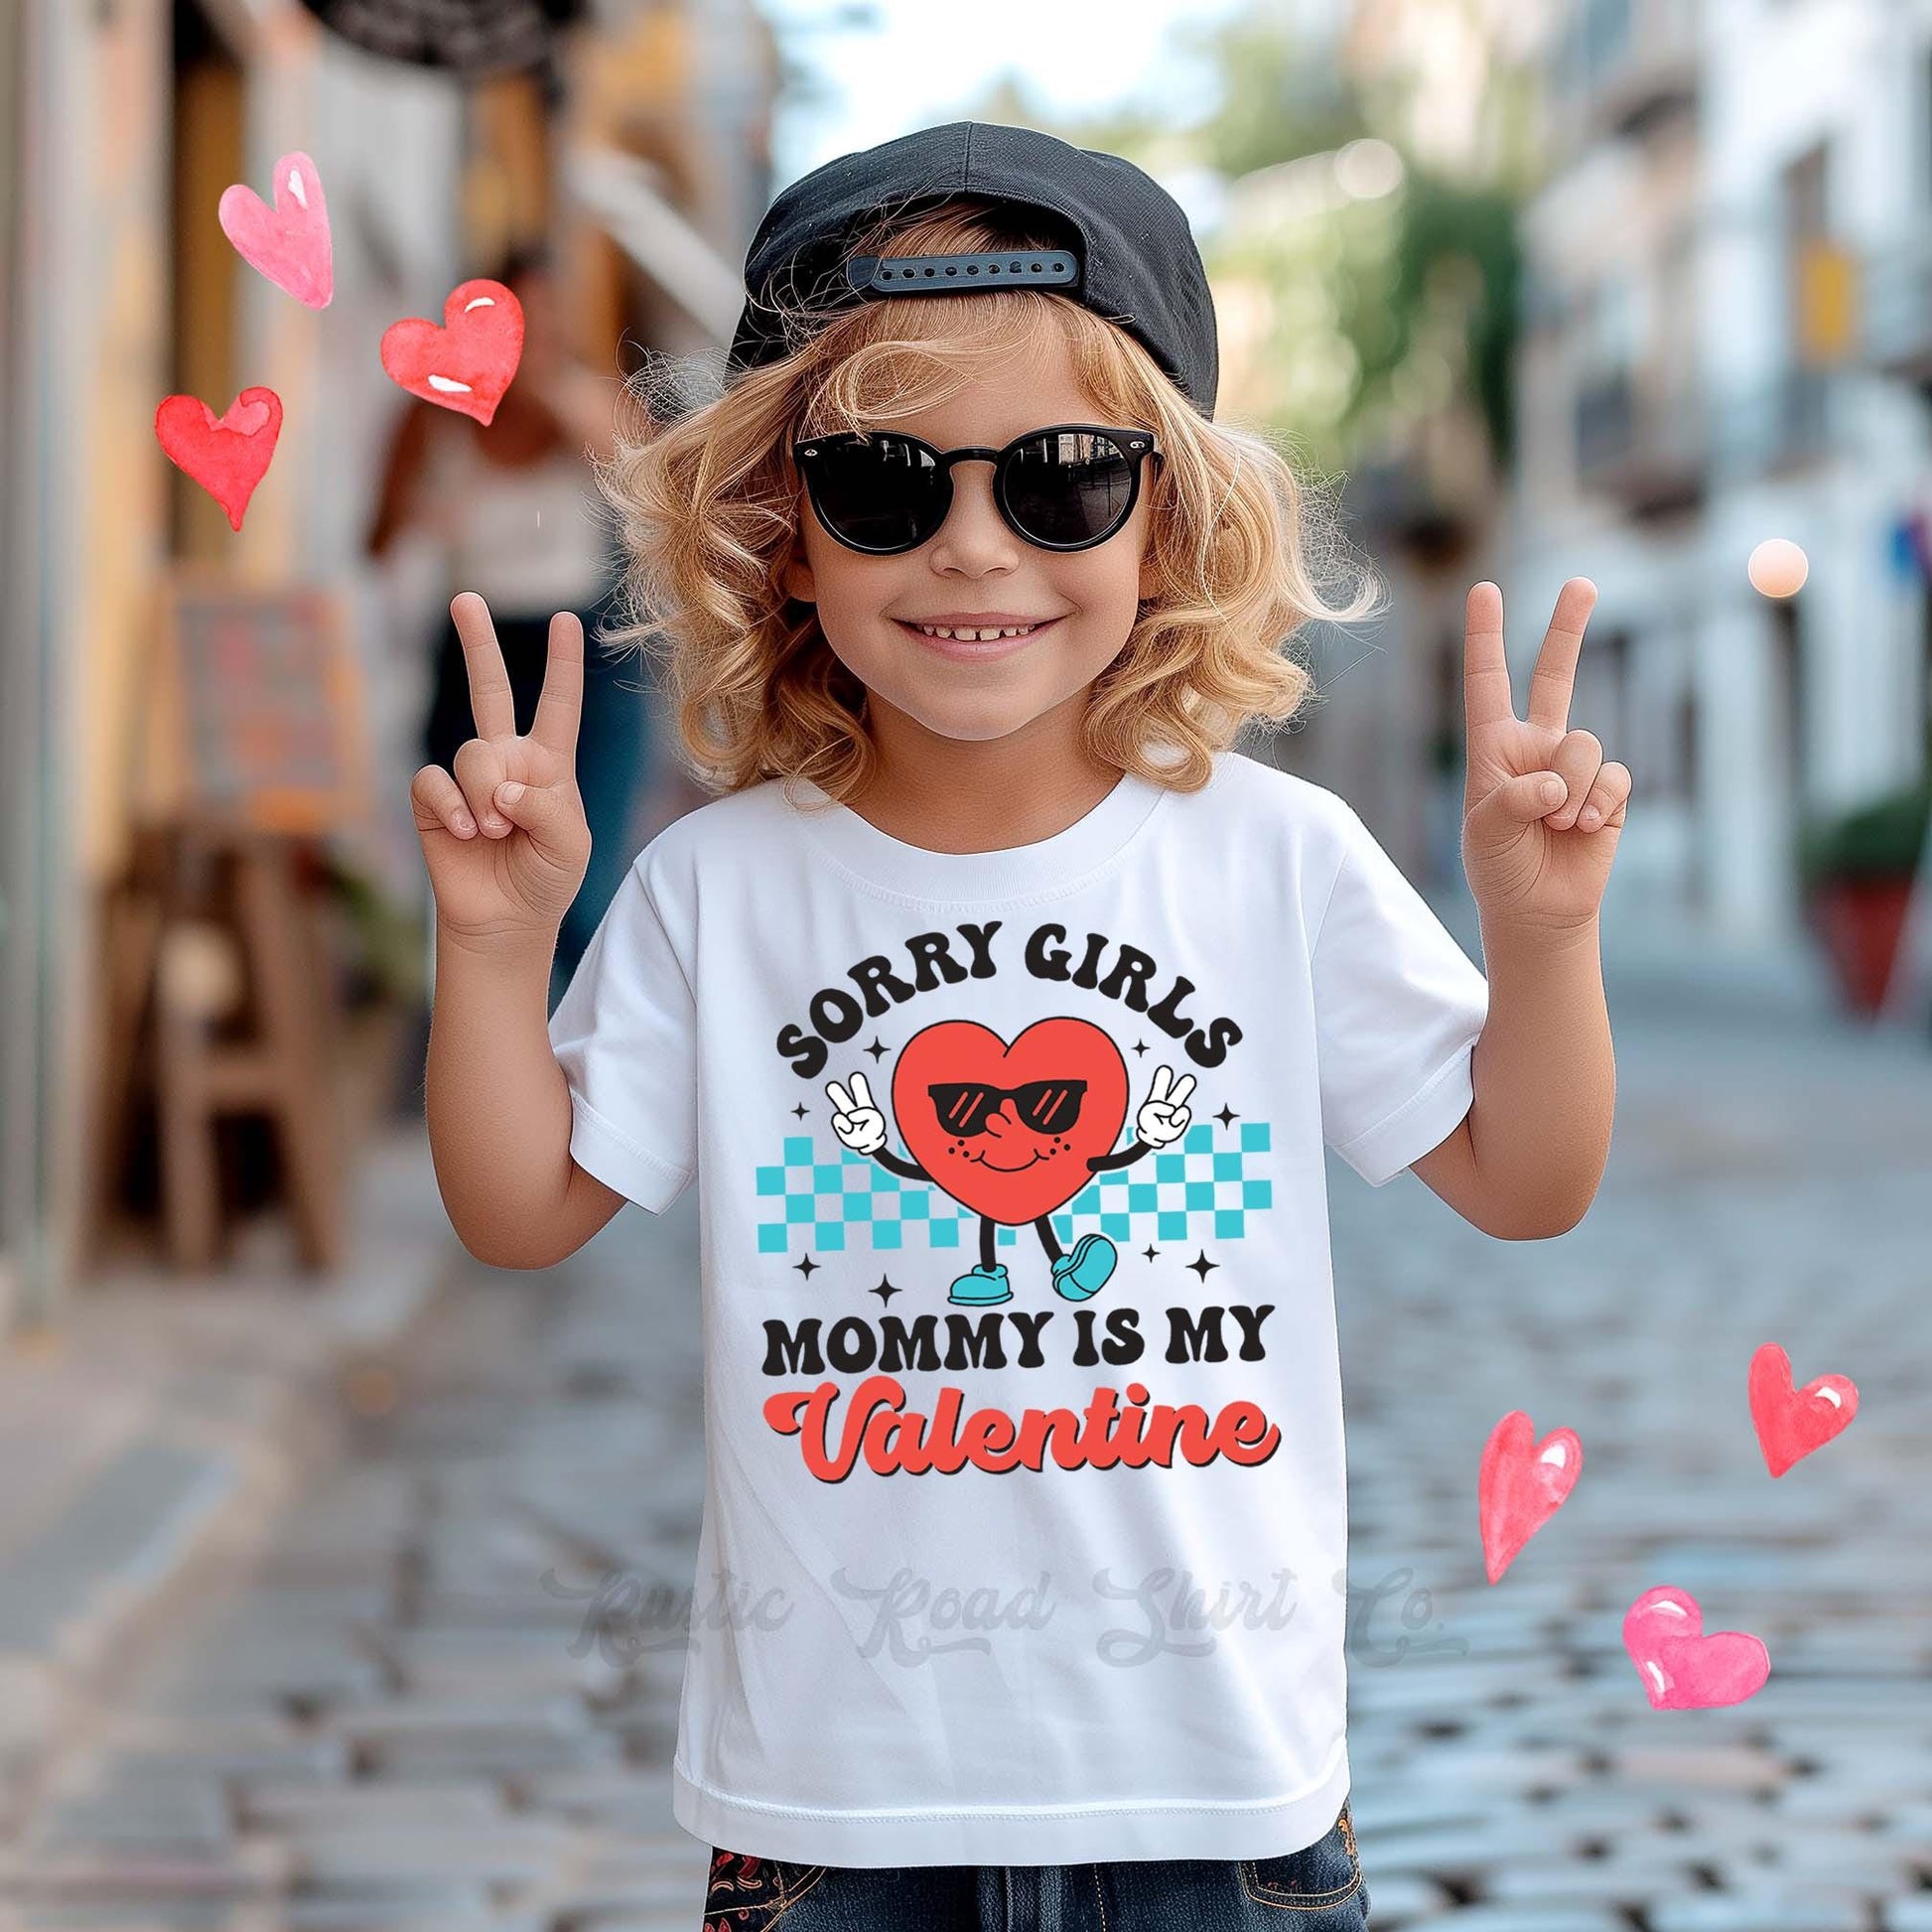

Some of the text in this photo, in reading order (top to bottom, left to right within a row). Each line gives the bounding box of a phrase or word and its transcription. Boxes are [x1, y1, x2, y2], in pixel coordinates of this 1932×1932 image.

[776, 920, 1243, 1079] SORRY GIRLS
[761, 1305, 1275, 1376] MOMMY IS MY
[762, 1375, 1282, 1483] Valentine
